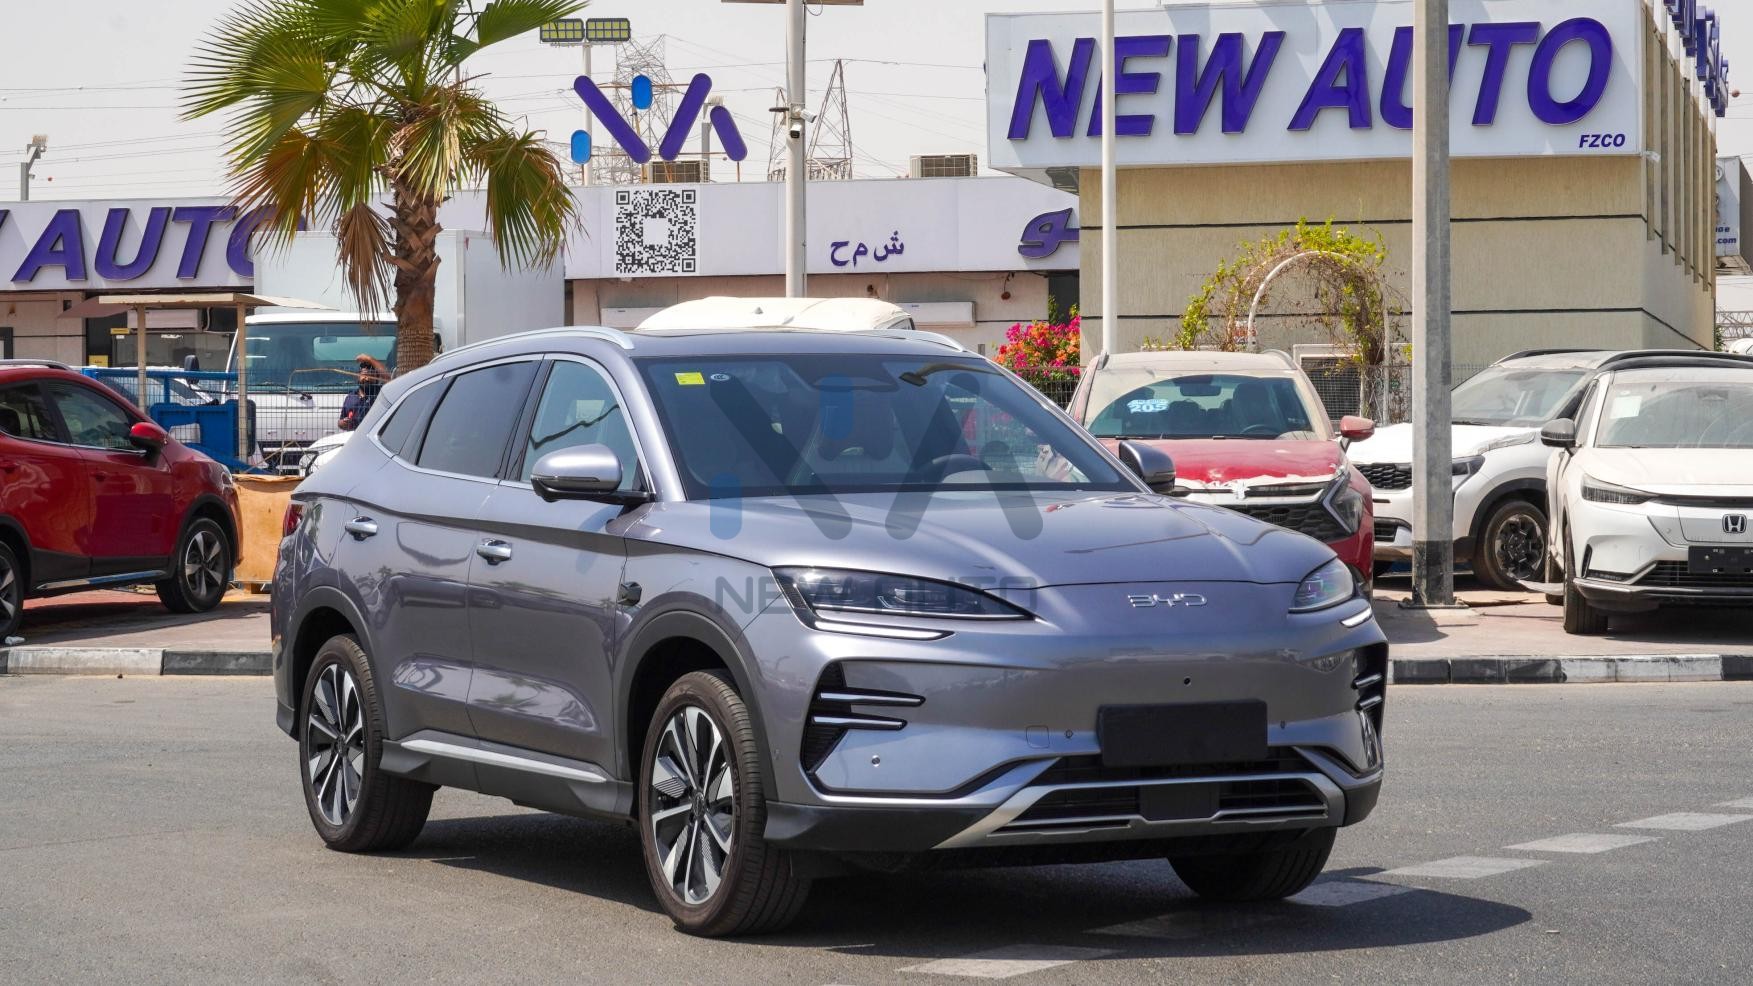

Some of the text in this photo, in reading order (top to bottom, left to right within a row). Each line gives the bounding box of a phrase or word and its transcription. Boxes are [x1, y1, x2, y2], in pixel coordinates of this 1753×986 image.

[1007, 31, 1286, 140] NEW
[1287, 17, 1613, 131] AUTO
[1579, 133, 1626, 148] FZCO
[1127, 593, 1208, 608] BYD
